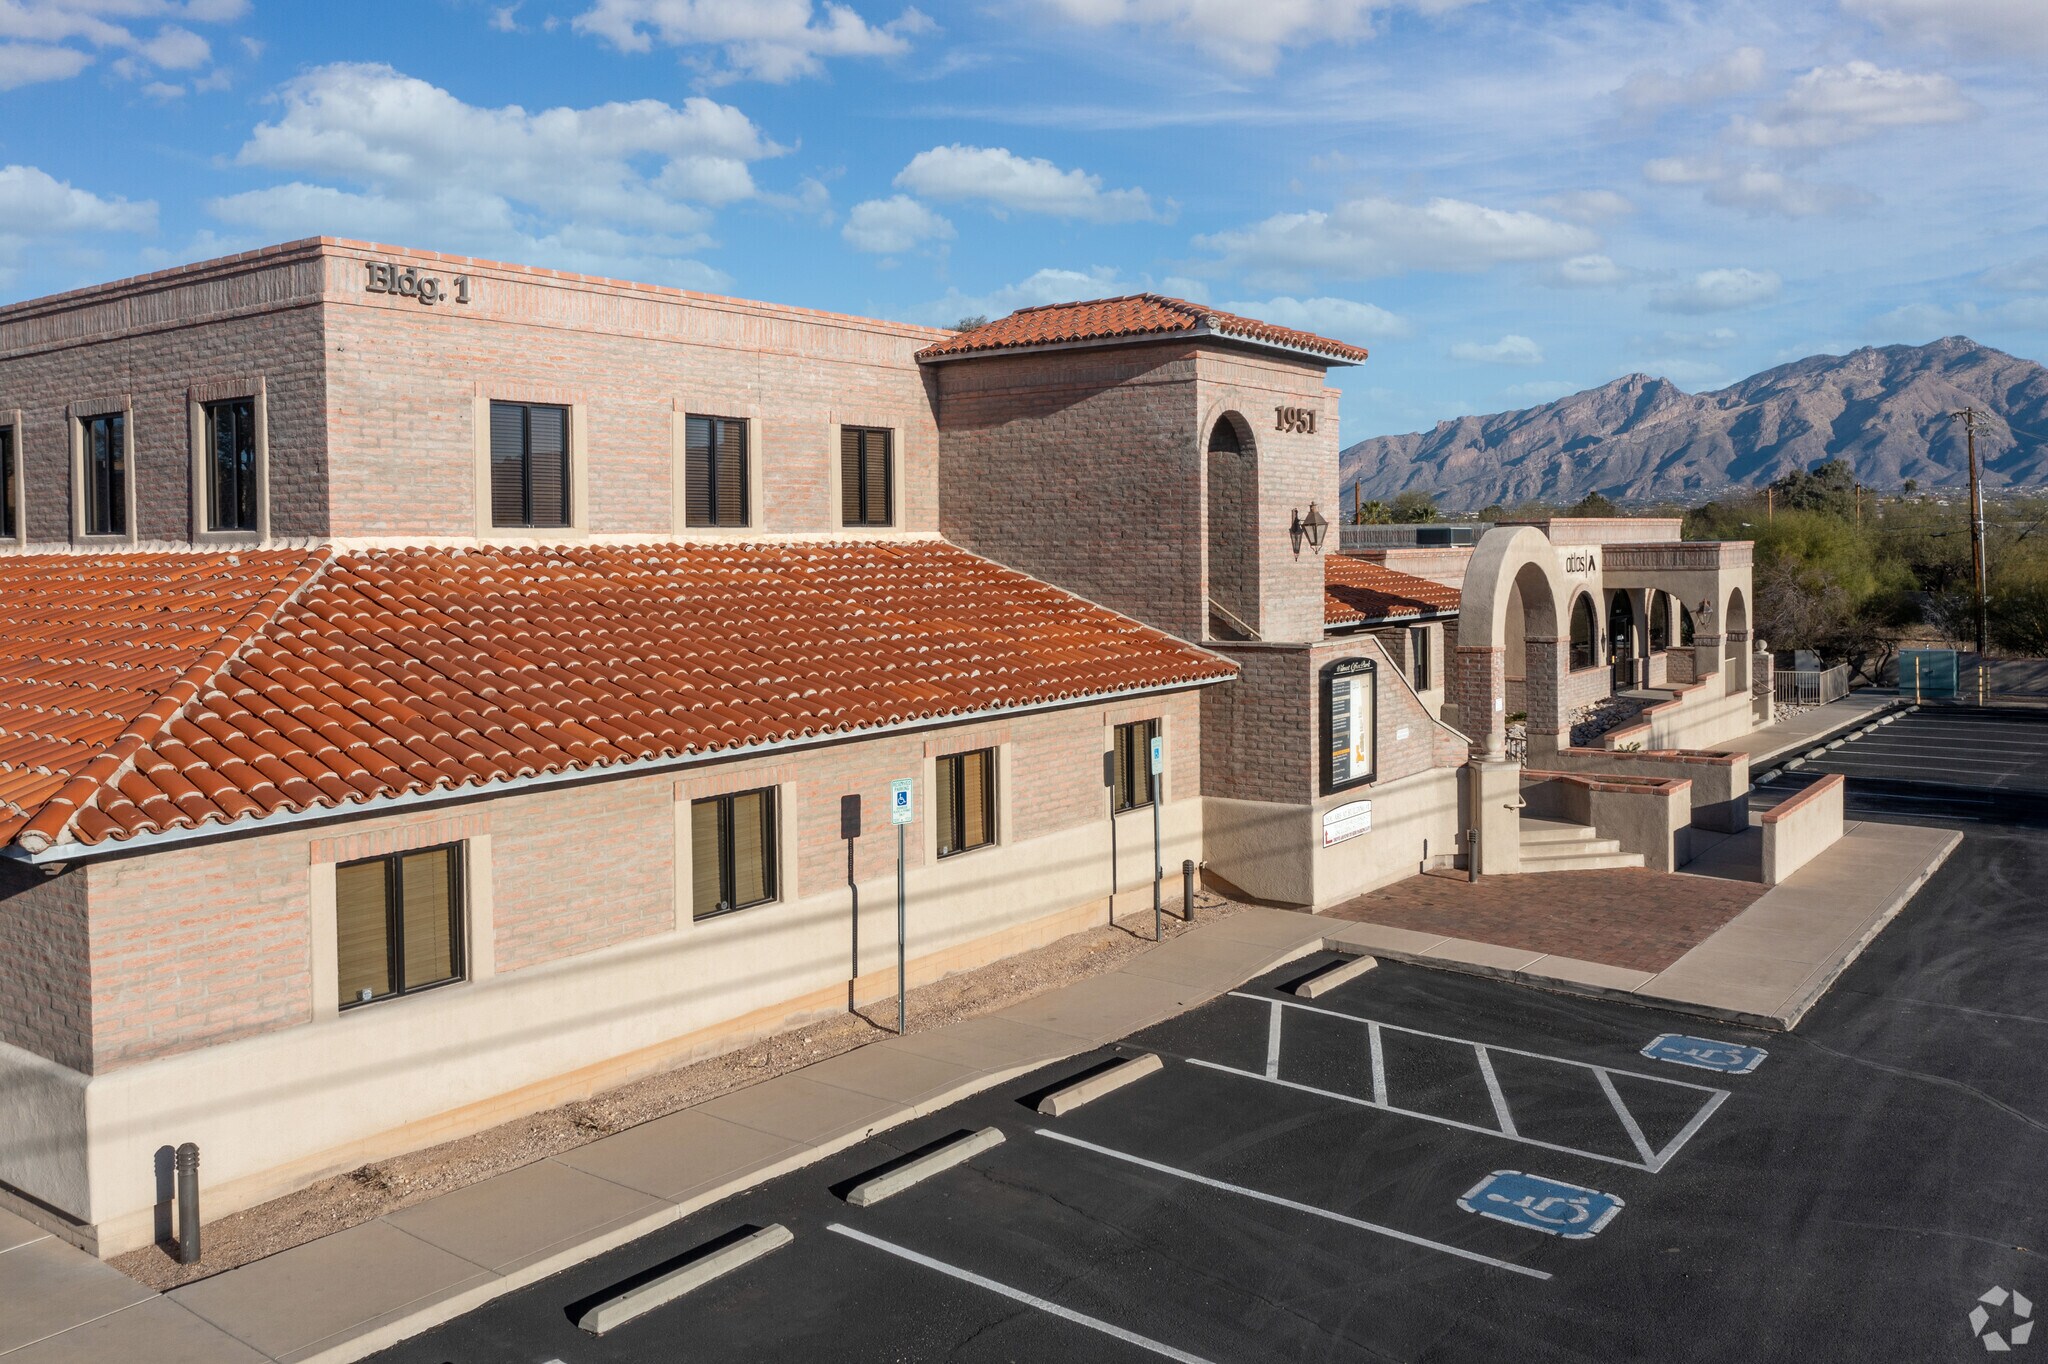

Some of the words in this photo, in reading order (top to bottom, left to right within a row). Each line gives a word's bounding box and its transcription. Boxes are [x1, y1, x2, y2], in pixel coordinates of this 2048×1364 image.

[366, 261, 447, 305] Bldg.
[454, 274, 471, 304] 1
[1275, 406, 1317, 434] 1951
